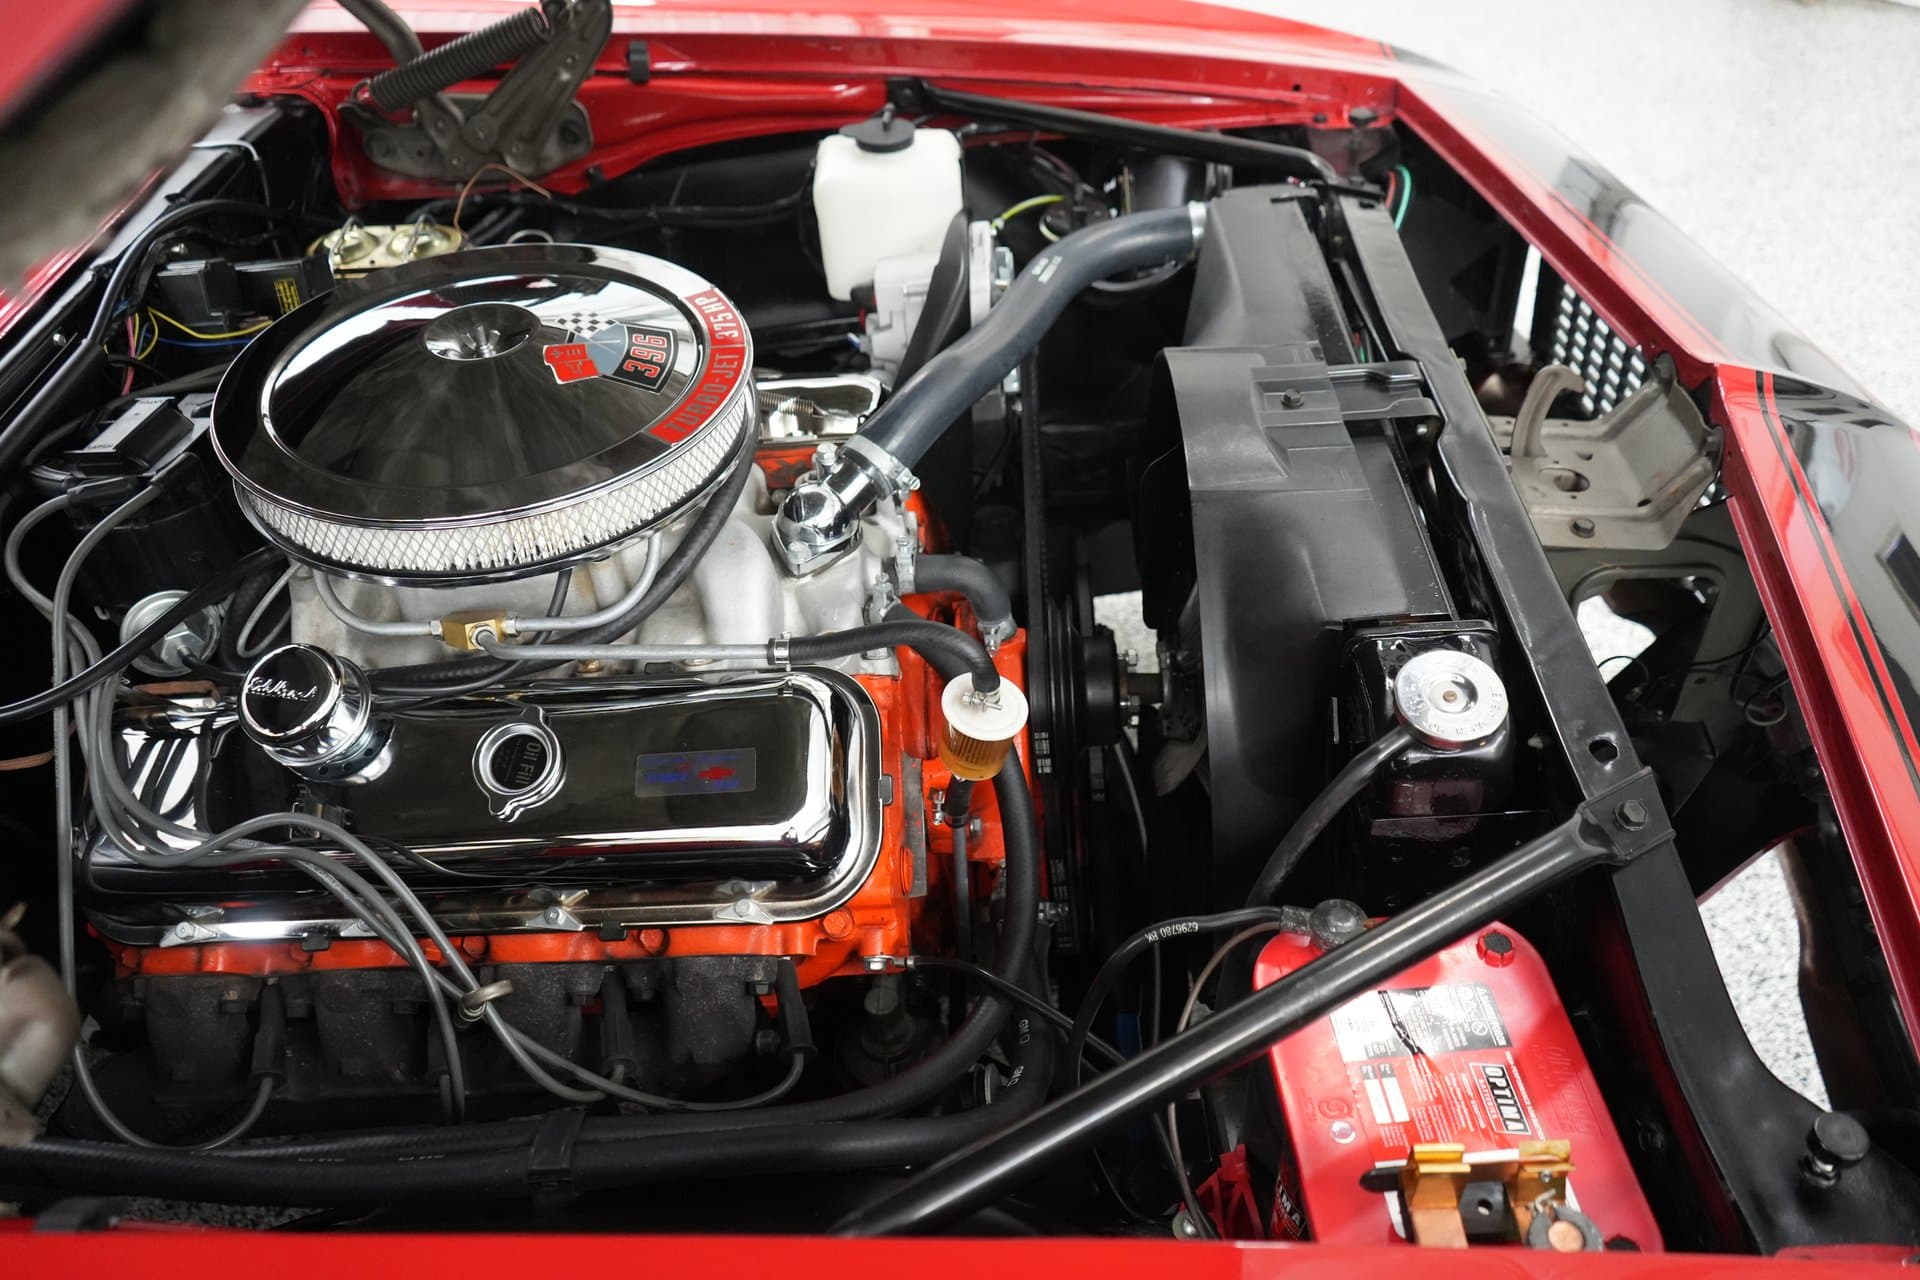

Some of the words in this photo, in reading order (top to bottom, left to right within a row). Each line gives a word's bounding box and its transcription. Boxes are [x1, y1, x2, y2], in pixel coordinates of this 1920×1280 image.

[623, 333, 668, 378] 396
[664, 353, 739, 433] TURBO-JET
[515, 763, 535, 785] Fill
[1144, 930, 1158, 943] BK
[1160, 921, 1198, 937] 6296780
[1482, 1066, 1525, 1131] OPTIMA
